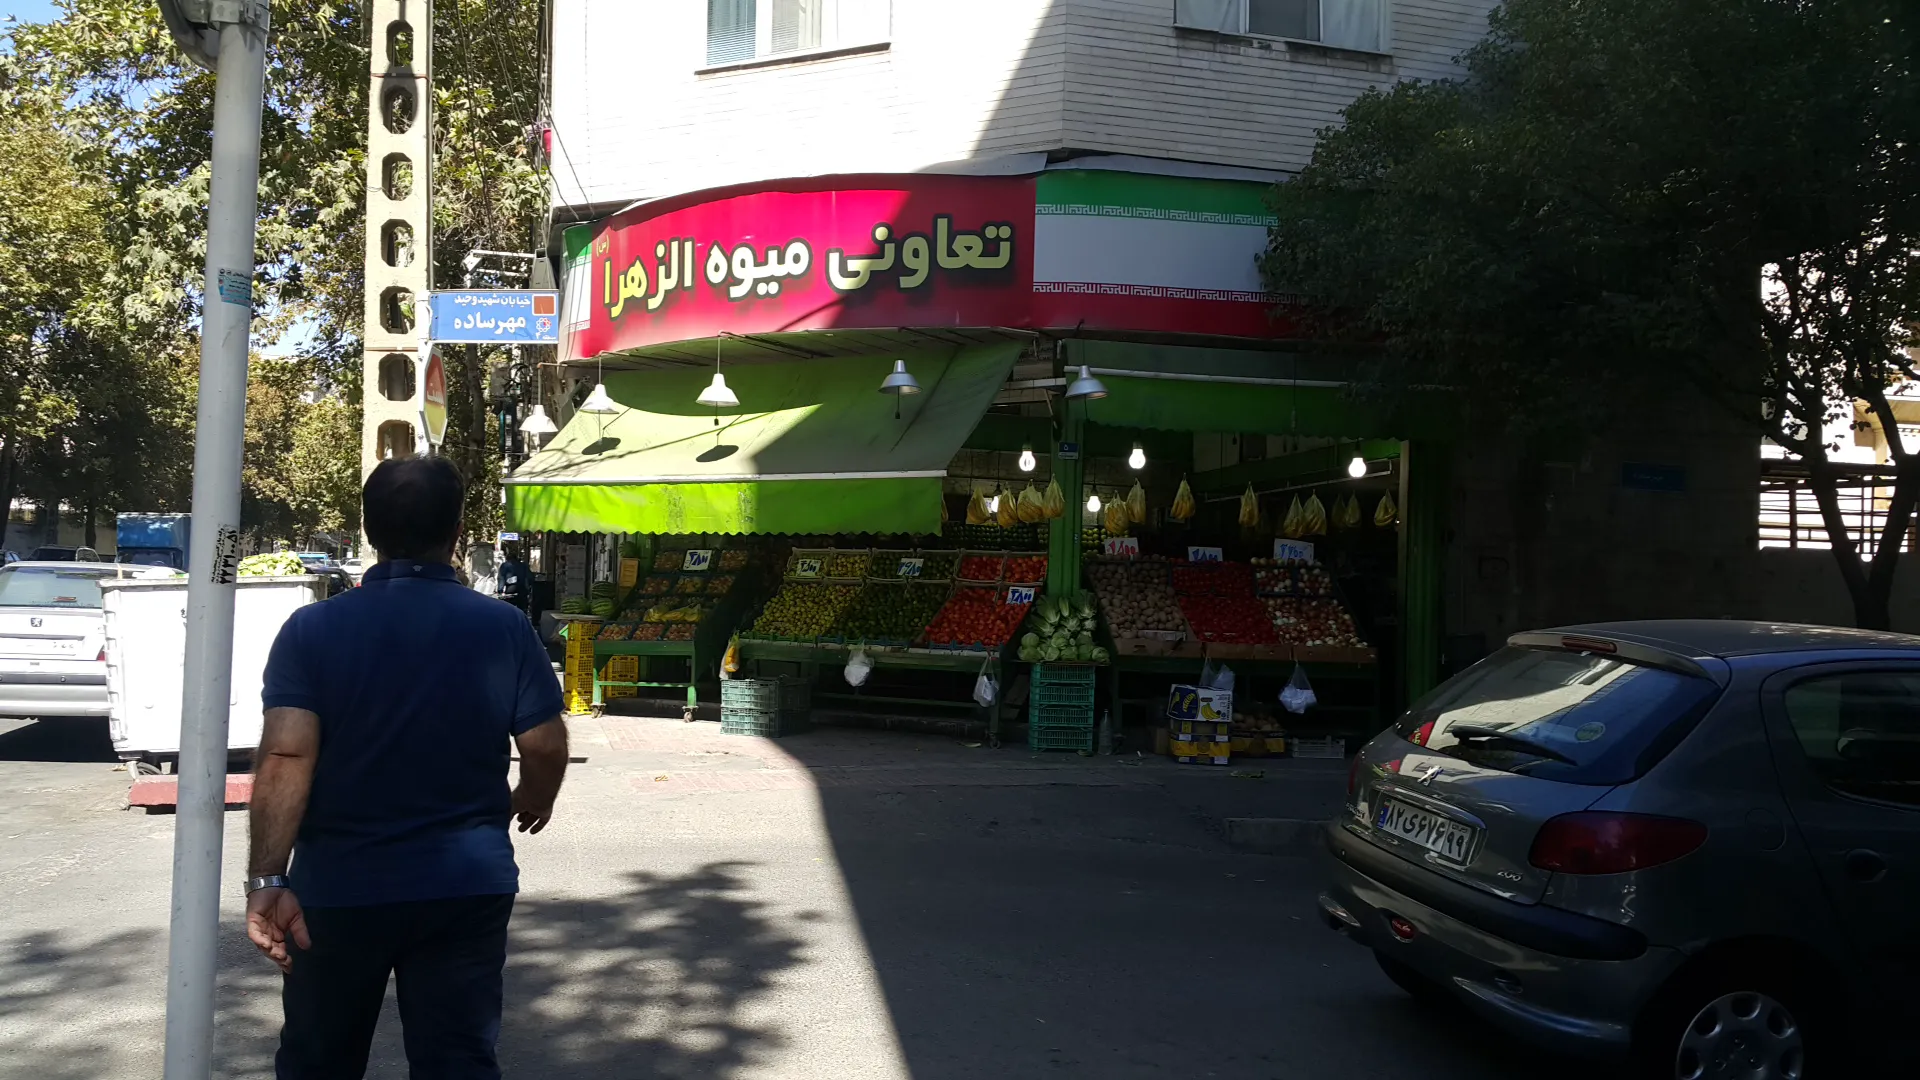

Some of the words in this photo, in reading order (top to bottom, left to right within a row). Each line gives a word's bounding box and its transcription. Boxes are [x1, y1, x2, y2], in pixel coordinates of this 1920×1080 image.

[603, 238, 695, 319] الزهرا
[706, 238, 811, 299] میوه
[828, 217, 1012, 291] تعاونی
[478, 293, 501, 307] شهید
[501, 295, 531, 308] خیابان
